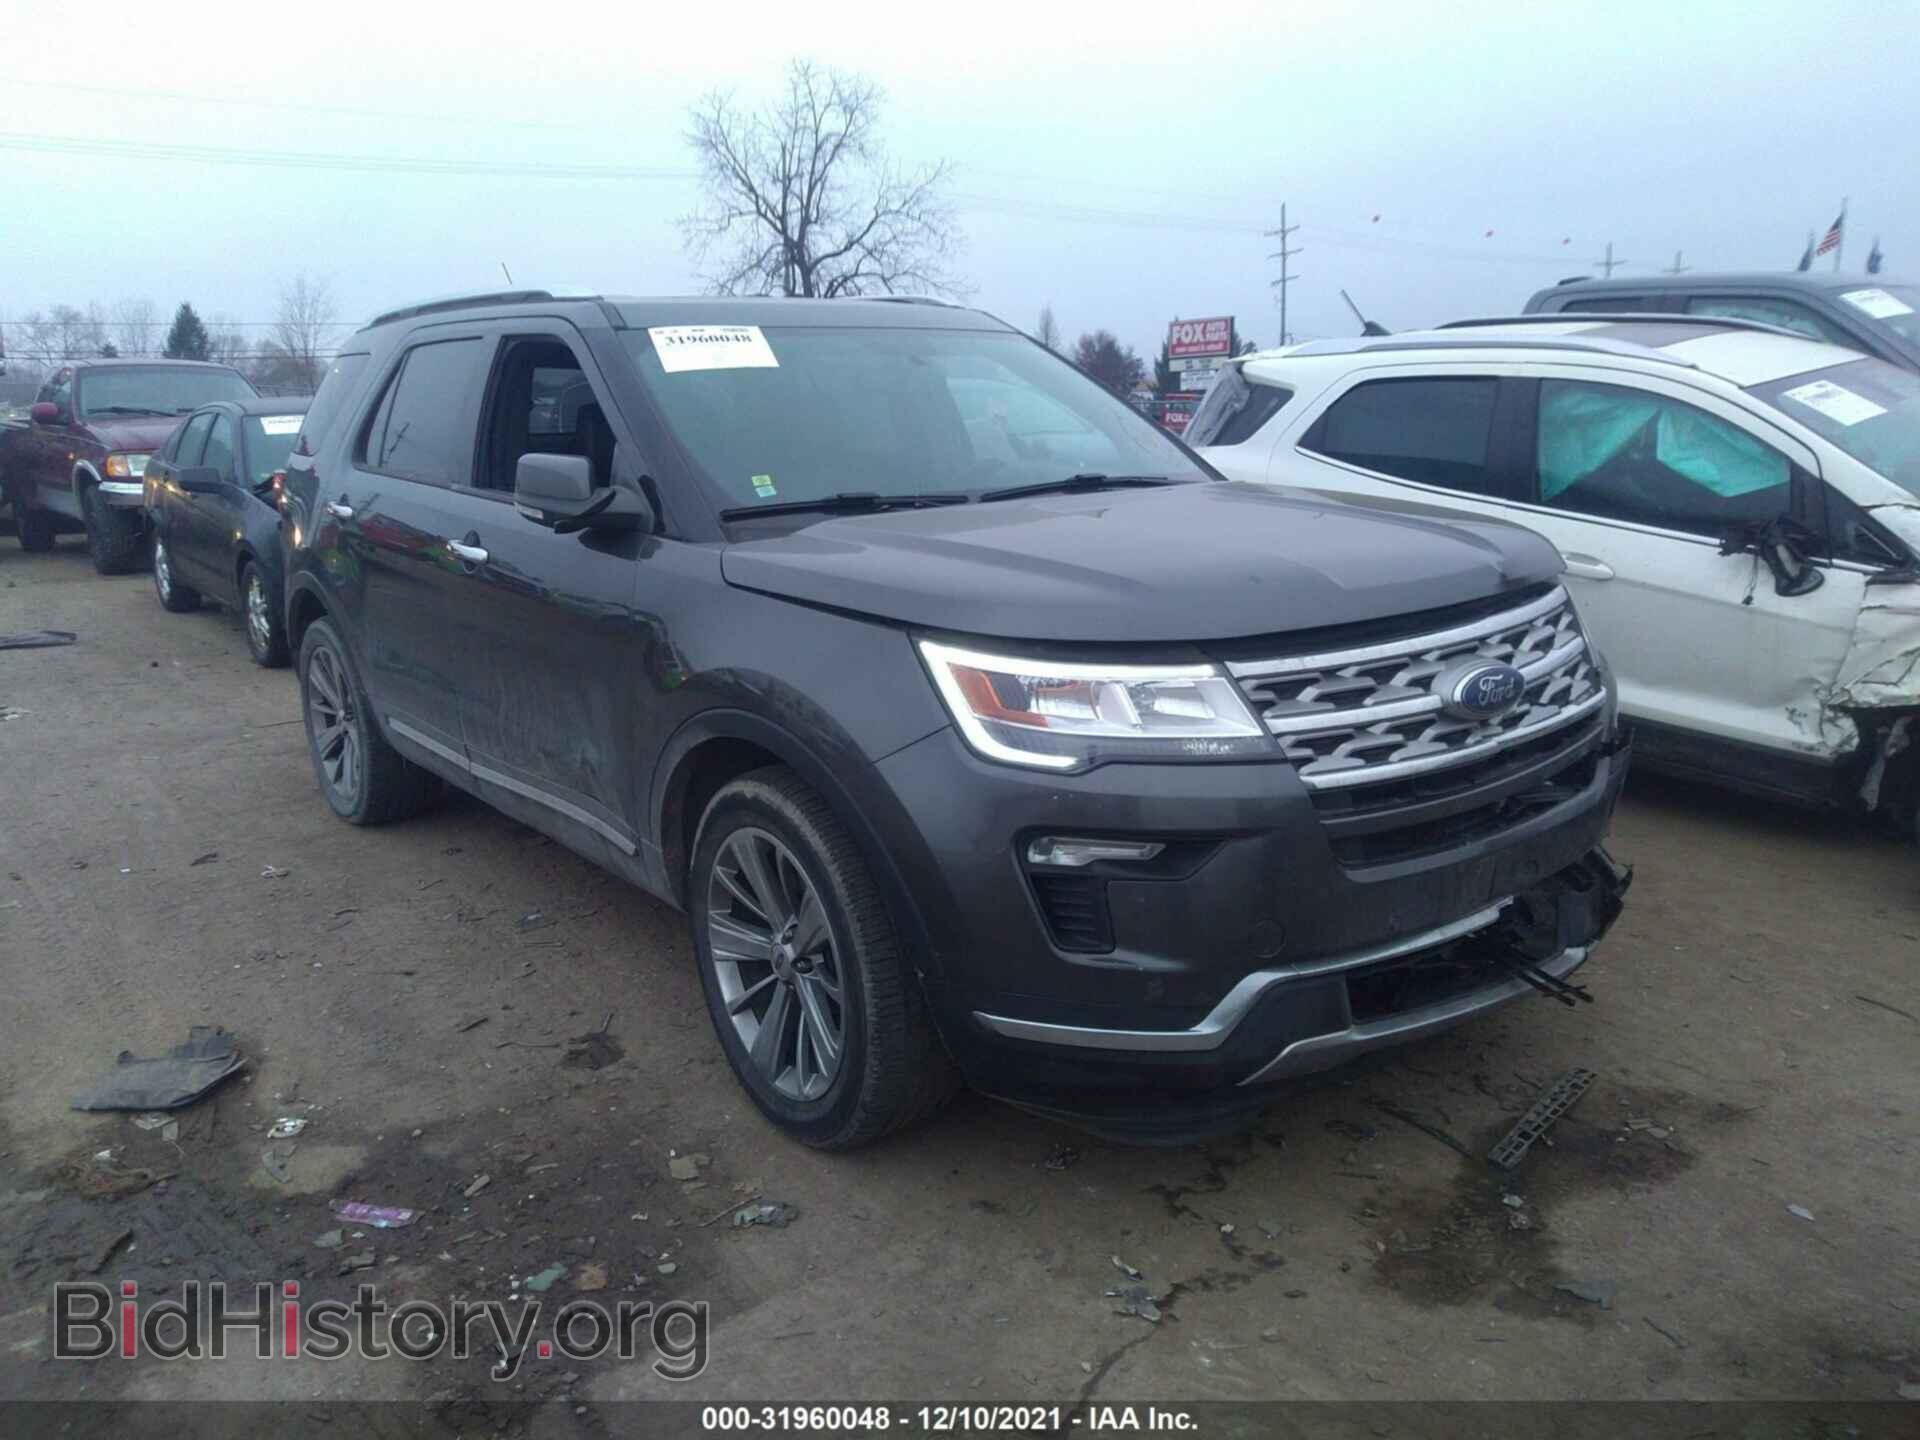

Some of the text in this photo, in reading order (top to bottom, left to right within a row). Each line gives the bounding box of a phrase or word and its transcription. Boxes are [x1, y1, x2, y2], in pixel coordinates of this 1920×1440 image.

[665, 334, 752, 346] 31960048
[1172, 323, 1206, 344] FOX
[1479, 675, 1515, 705] Ford
